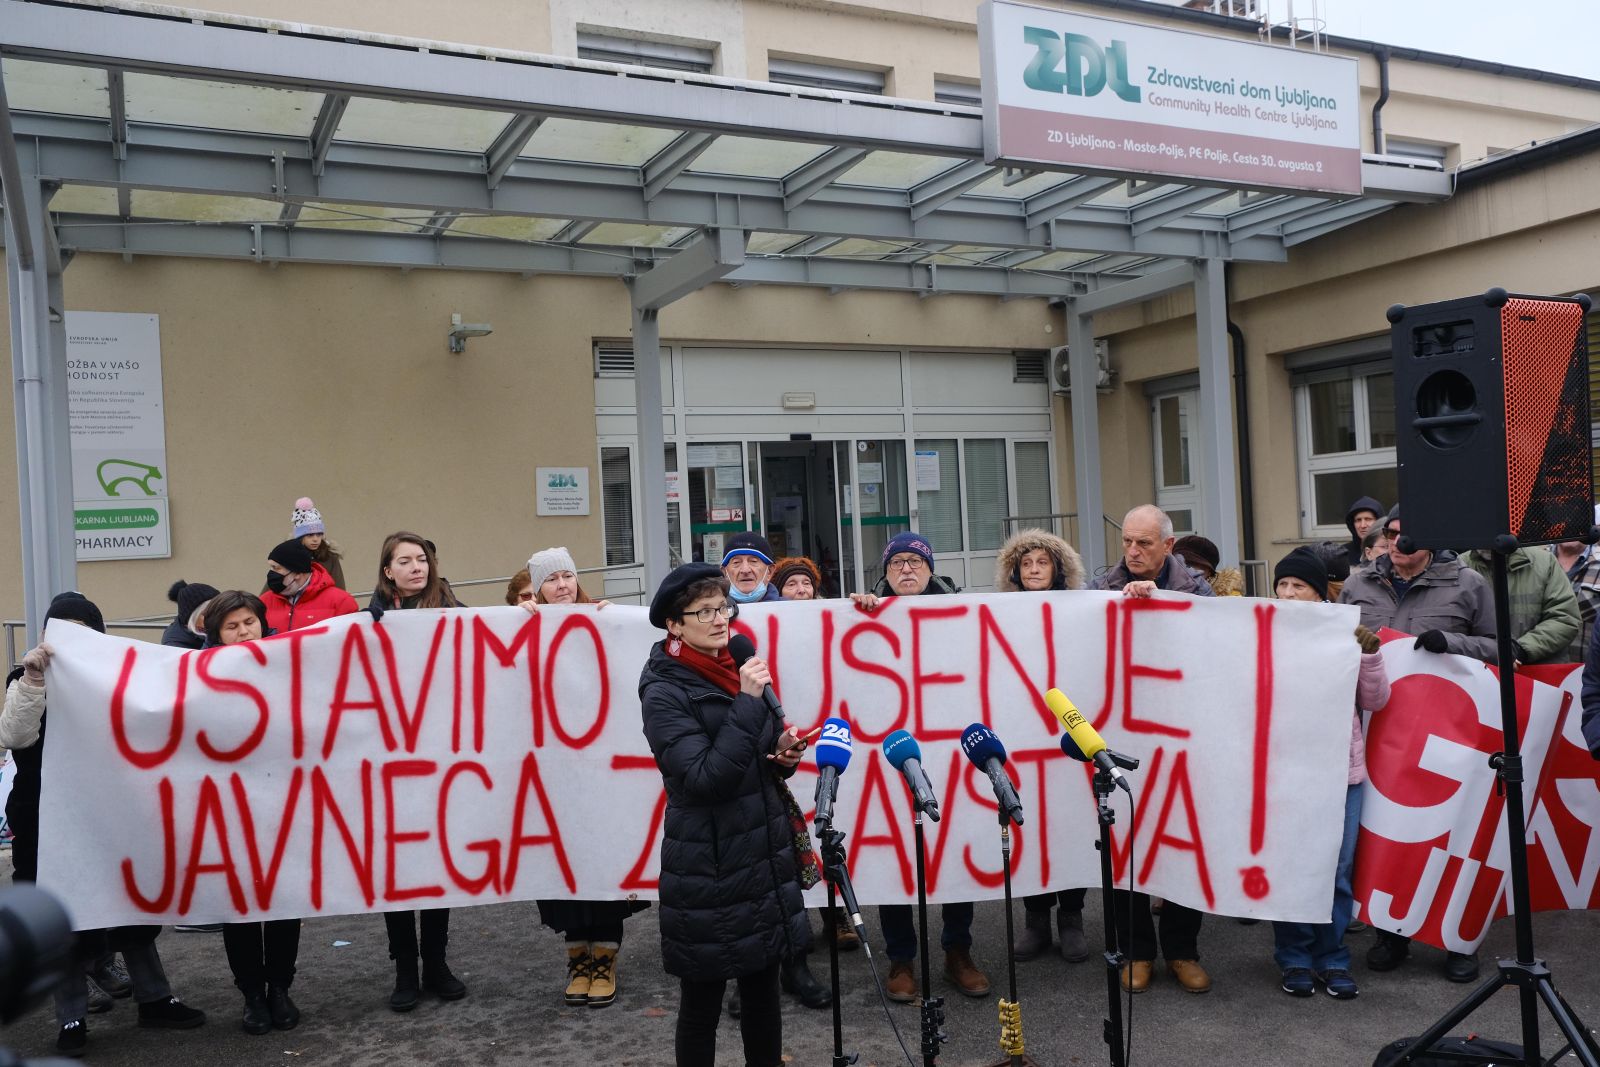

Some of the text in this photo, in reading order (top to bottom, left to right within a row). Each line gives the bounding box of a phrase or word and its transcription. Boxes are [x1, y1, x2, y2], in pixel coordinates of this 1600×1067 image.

[1023, 25, 1142, 103] ZDL
[1147, 66, 1337, 111] Zdravstveni dom Ljubljana
[1148, 92, 1338, 131] Community Health Centre Ljubljana
[1047, 130, 1063, 143] ZD
[1065, 132, 1116, 150] Ljubljana
[1123, 139, 1187, 159] Moste-Polje,
[1189, 146, 1202, 159] PE
[1203, 148, 1231, 164] Polje,
[1233, 152, 1259, 165] Cesta
[1260, 154, 1277, 168] 30.
[1278, 158, 1315, 172] avgusta
[1316, 161, 1323, 172] 2
[67, 359, 140, 370] OŽBA V VAŠO
[75, 514, 156, 525] KARNA LJUBLJANA
[76, 535, 154, 550] PHARMACY
[110, 613, 610, 769] USTAVIMO
[967, 730, 979, 742] RTV
[970, 735, 984, 748] SLO
[121, 751, 577, 914] JAVNEGA
